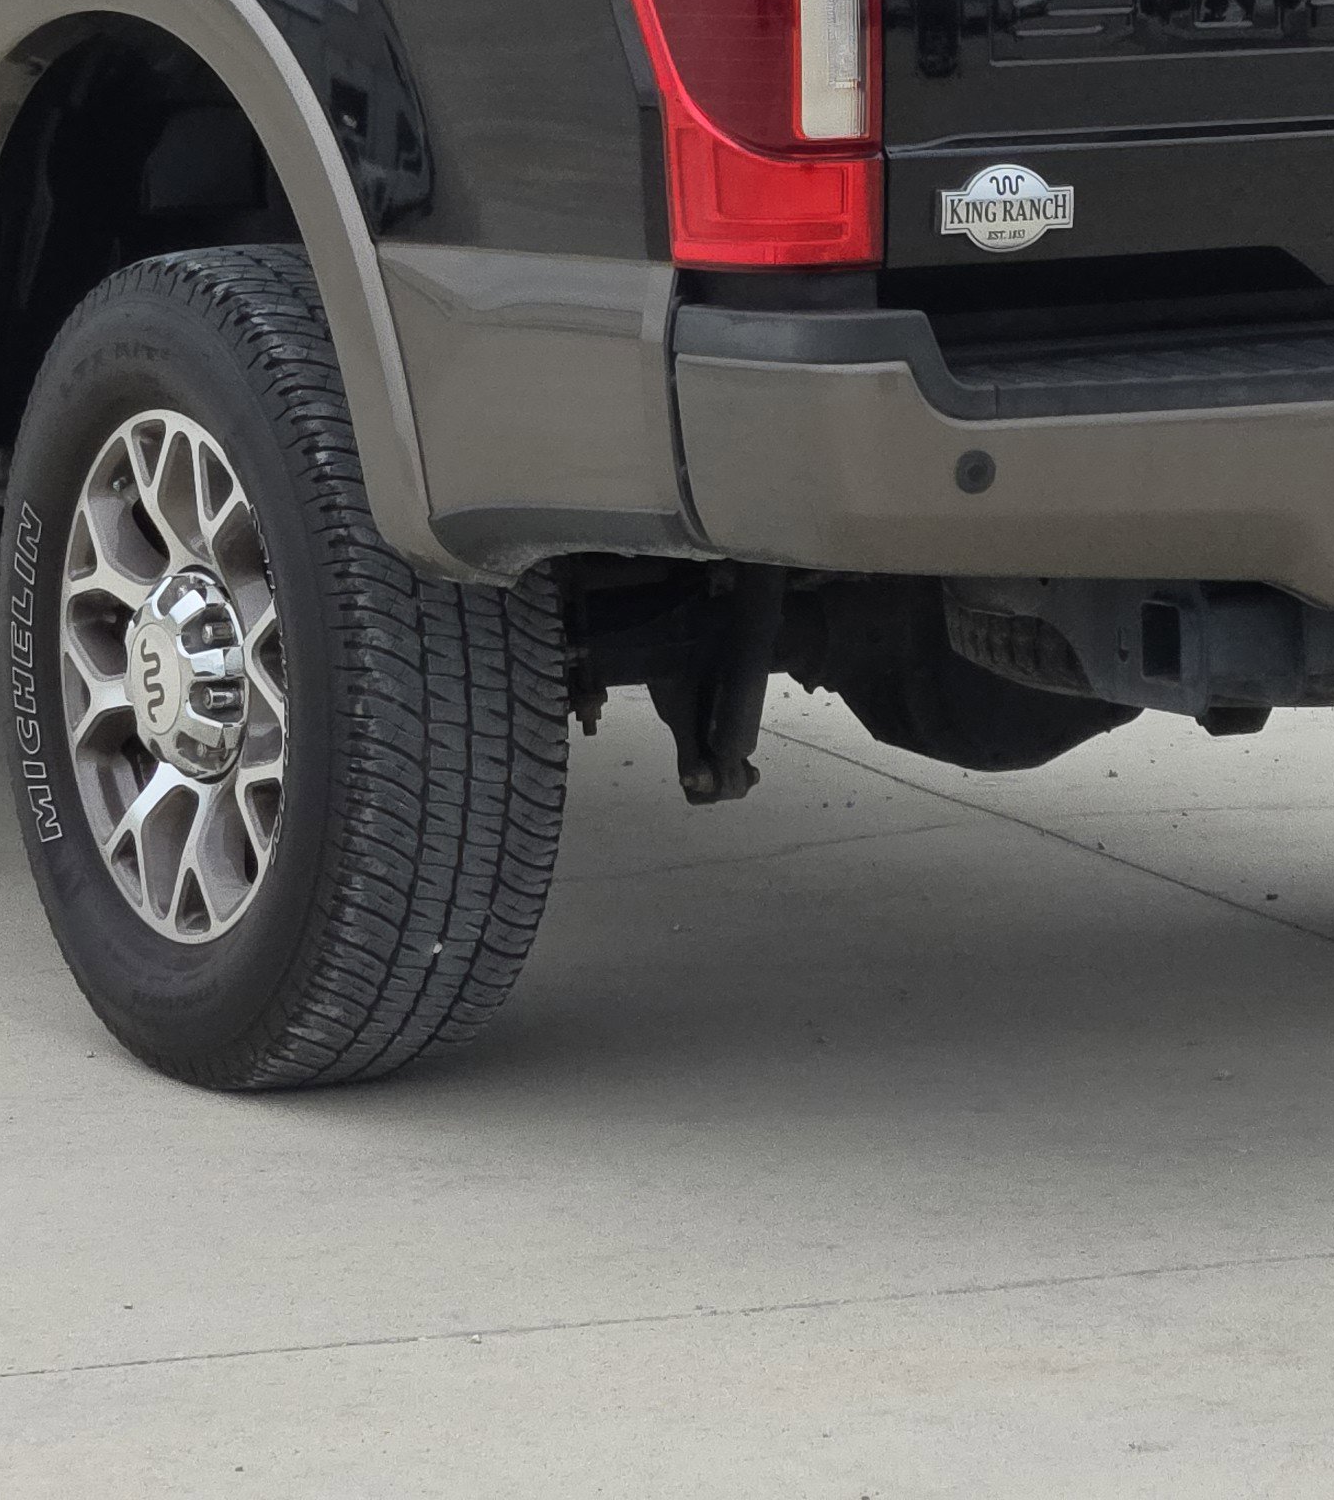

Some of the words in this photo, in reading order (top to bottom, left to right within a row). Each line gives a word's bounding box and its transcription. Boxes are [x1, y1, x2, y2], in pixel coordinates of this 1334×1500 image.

[949, 198, 997, 224] KING
[1002, 194, 1067, 222] RANCH
[10, 501, 62, 843] MICHELIN
